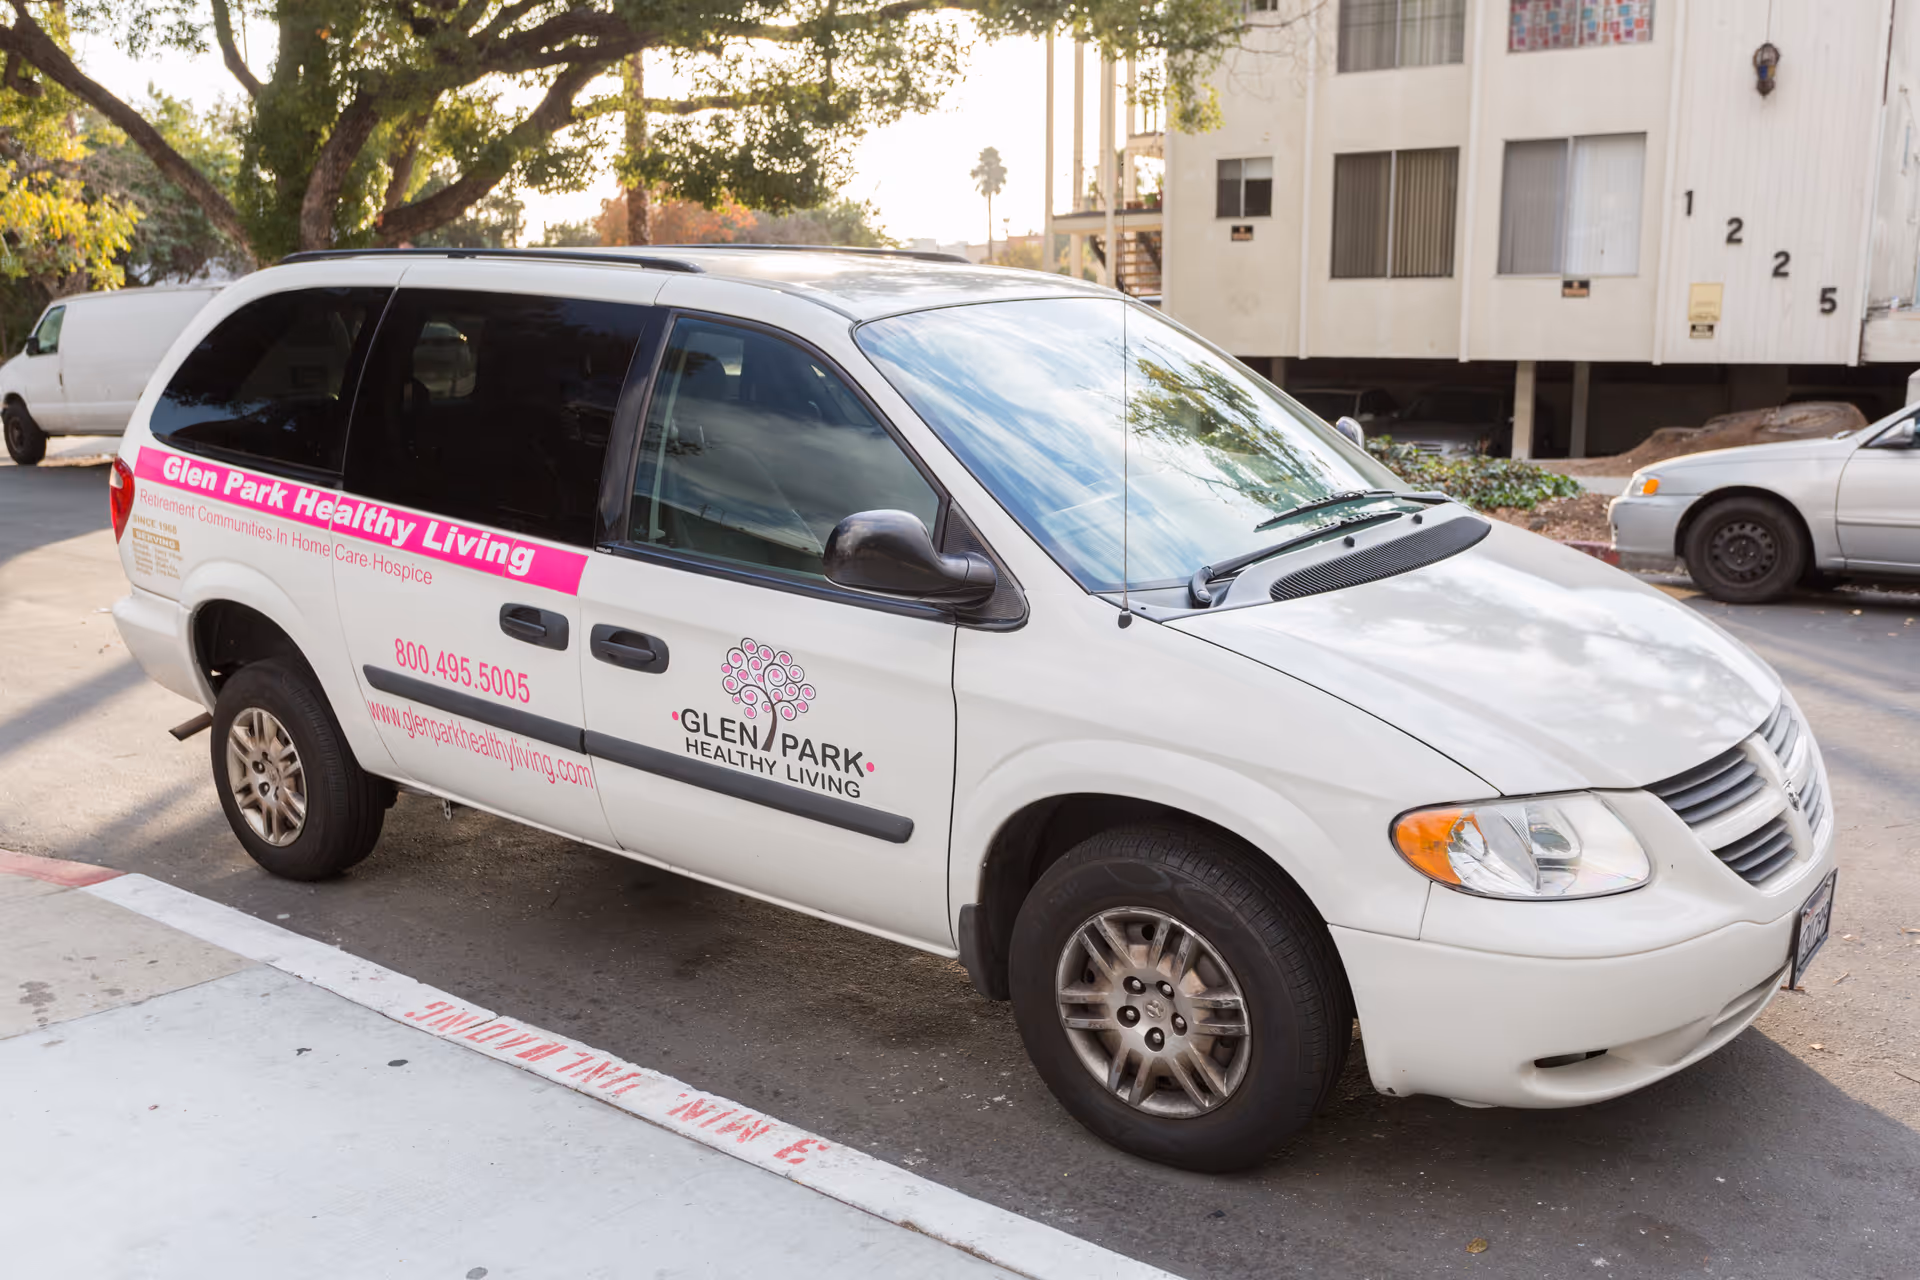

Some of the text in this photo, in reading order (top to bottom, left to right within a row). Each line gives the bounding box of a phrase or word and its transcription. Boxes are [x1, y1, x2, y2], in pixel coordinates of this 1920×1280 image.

[140, 488, 195, 519] Retirement
[292, 531, 331, 557] Home
[163, 456, 536, 577] Glen Park Healthy Living
[394, 638, 531, 704] 800.495.5005
[367, 700, 594, 789] www.glenparkhealthyliving.com
[681, 708, 865, 778] GLEN PARK
[685, 737, 861, 799] HEALTHY LIVING
